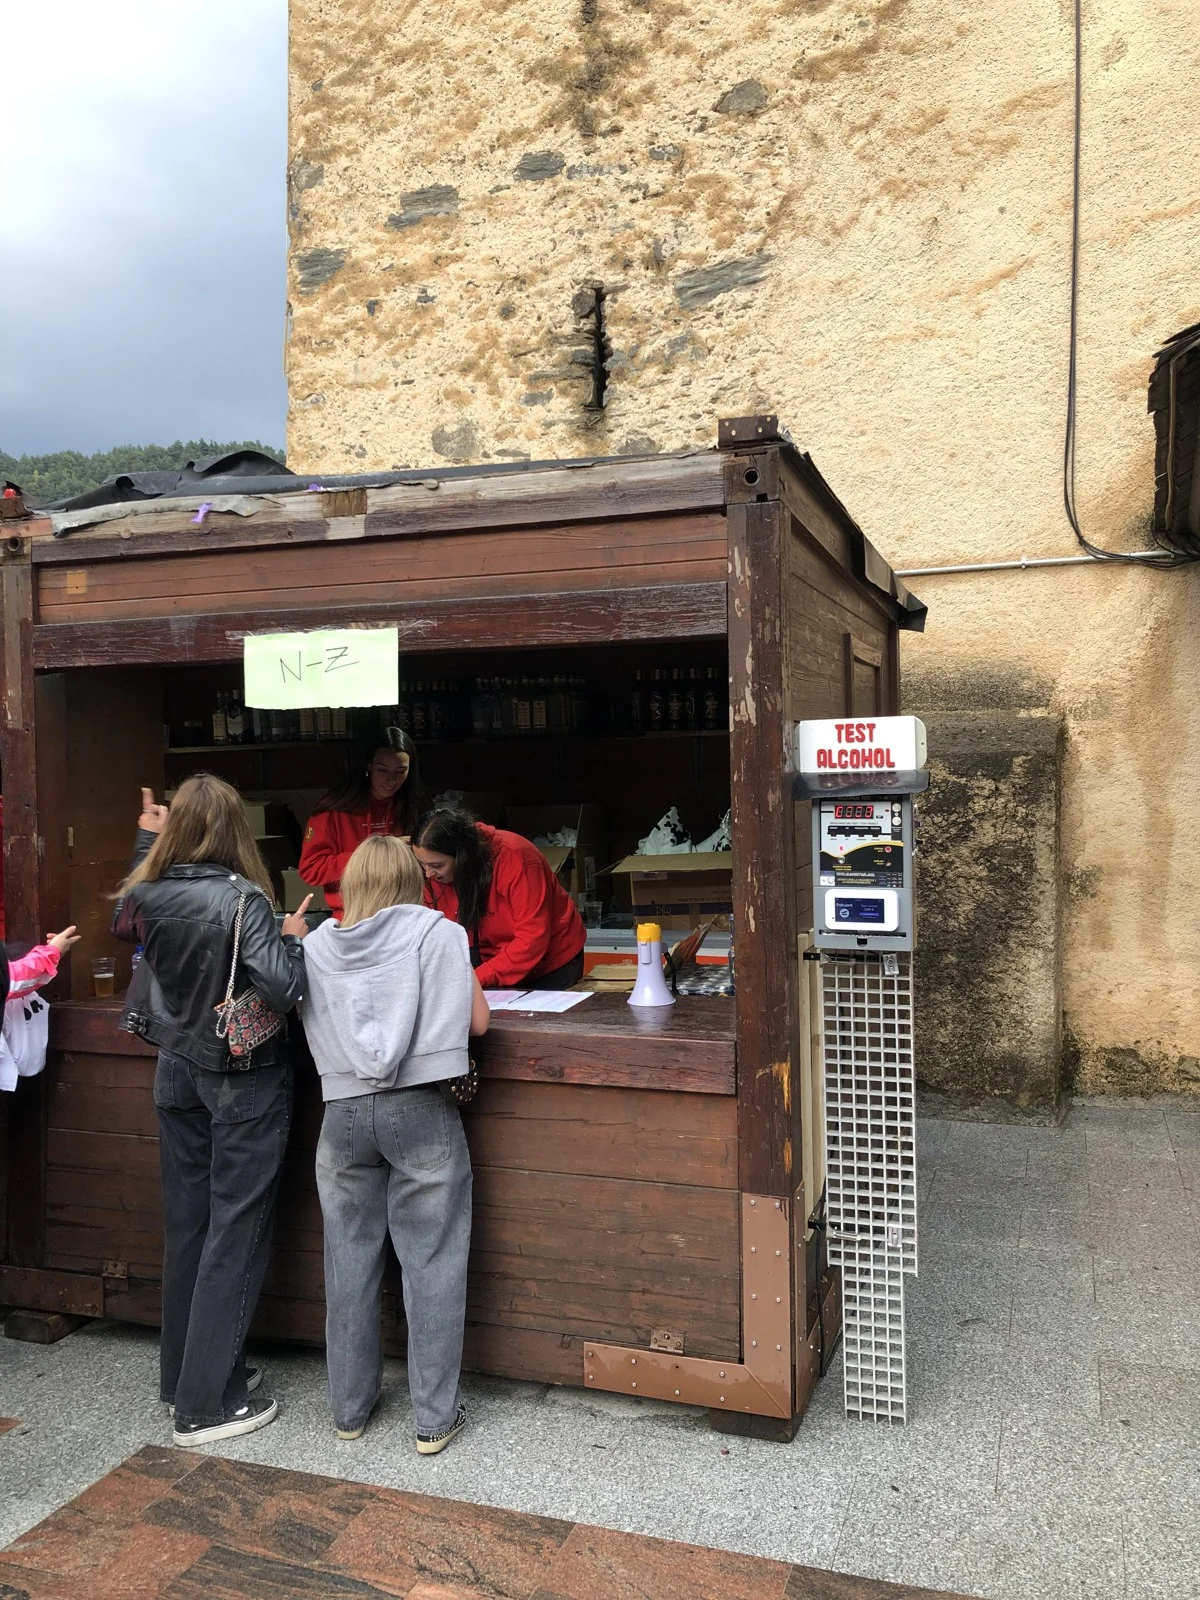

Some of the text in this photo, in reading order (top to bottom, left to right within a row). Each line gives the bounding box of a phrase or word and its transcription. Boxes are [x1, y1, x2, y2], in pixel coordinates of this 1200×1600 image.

[280, 646, 360, 683] N-Z
[834, 723, 876, 744] TEST
[816, 748, 895, 769] ALCOHOL
